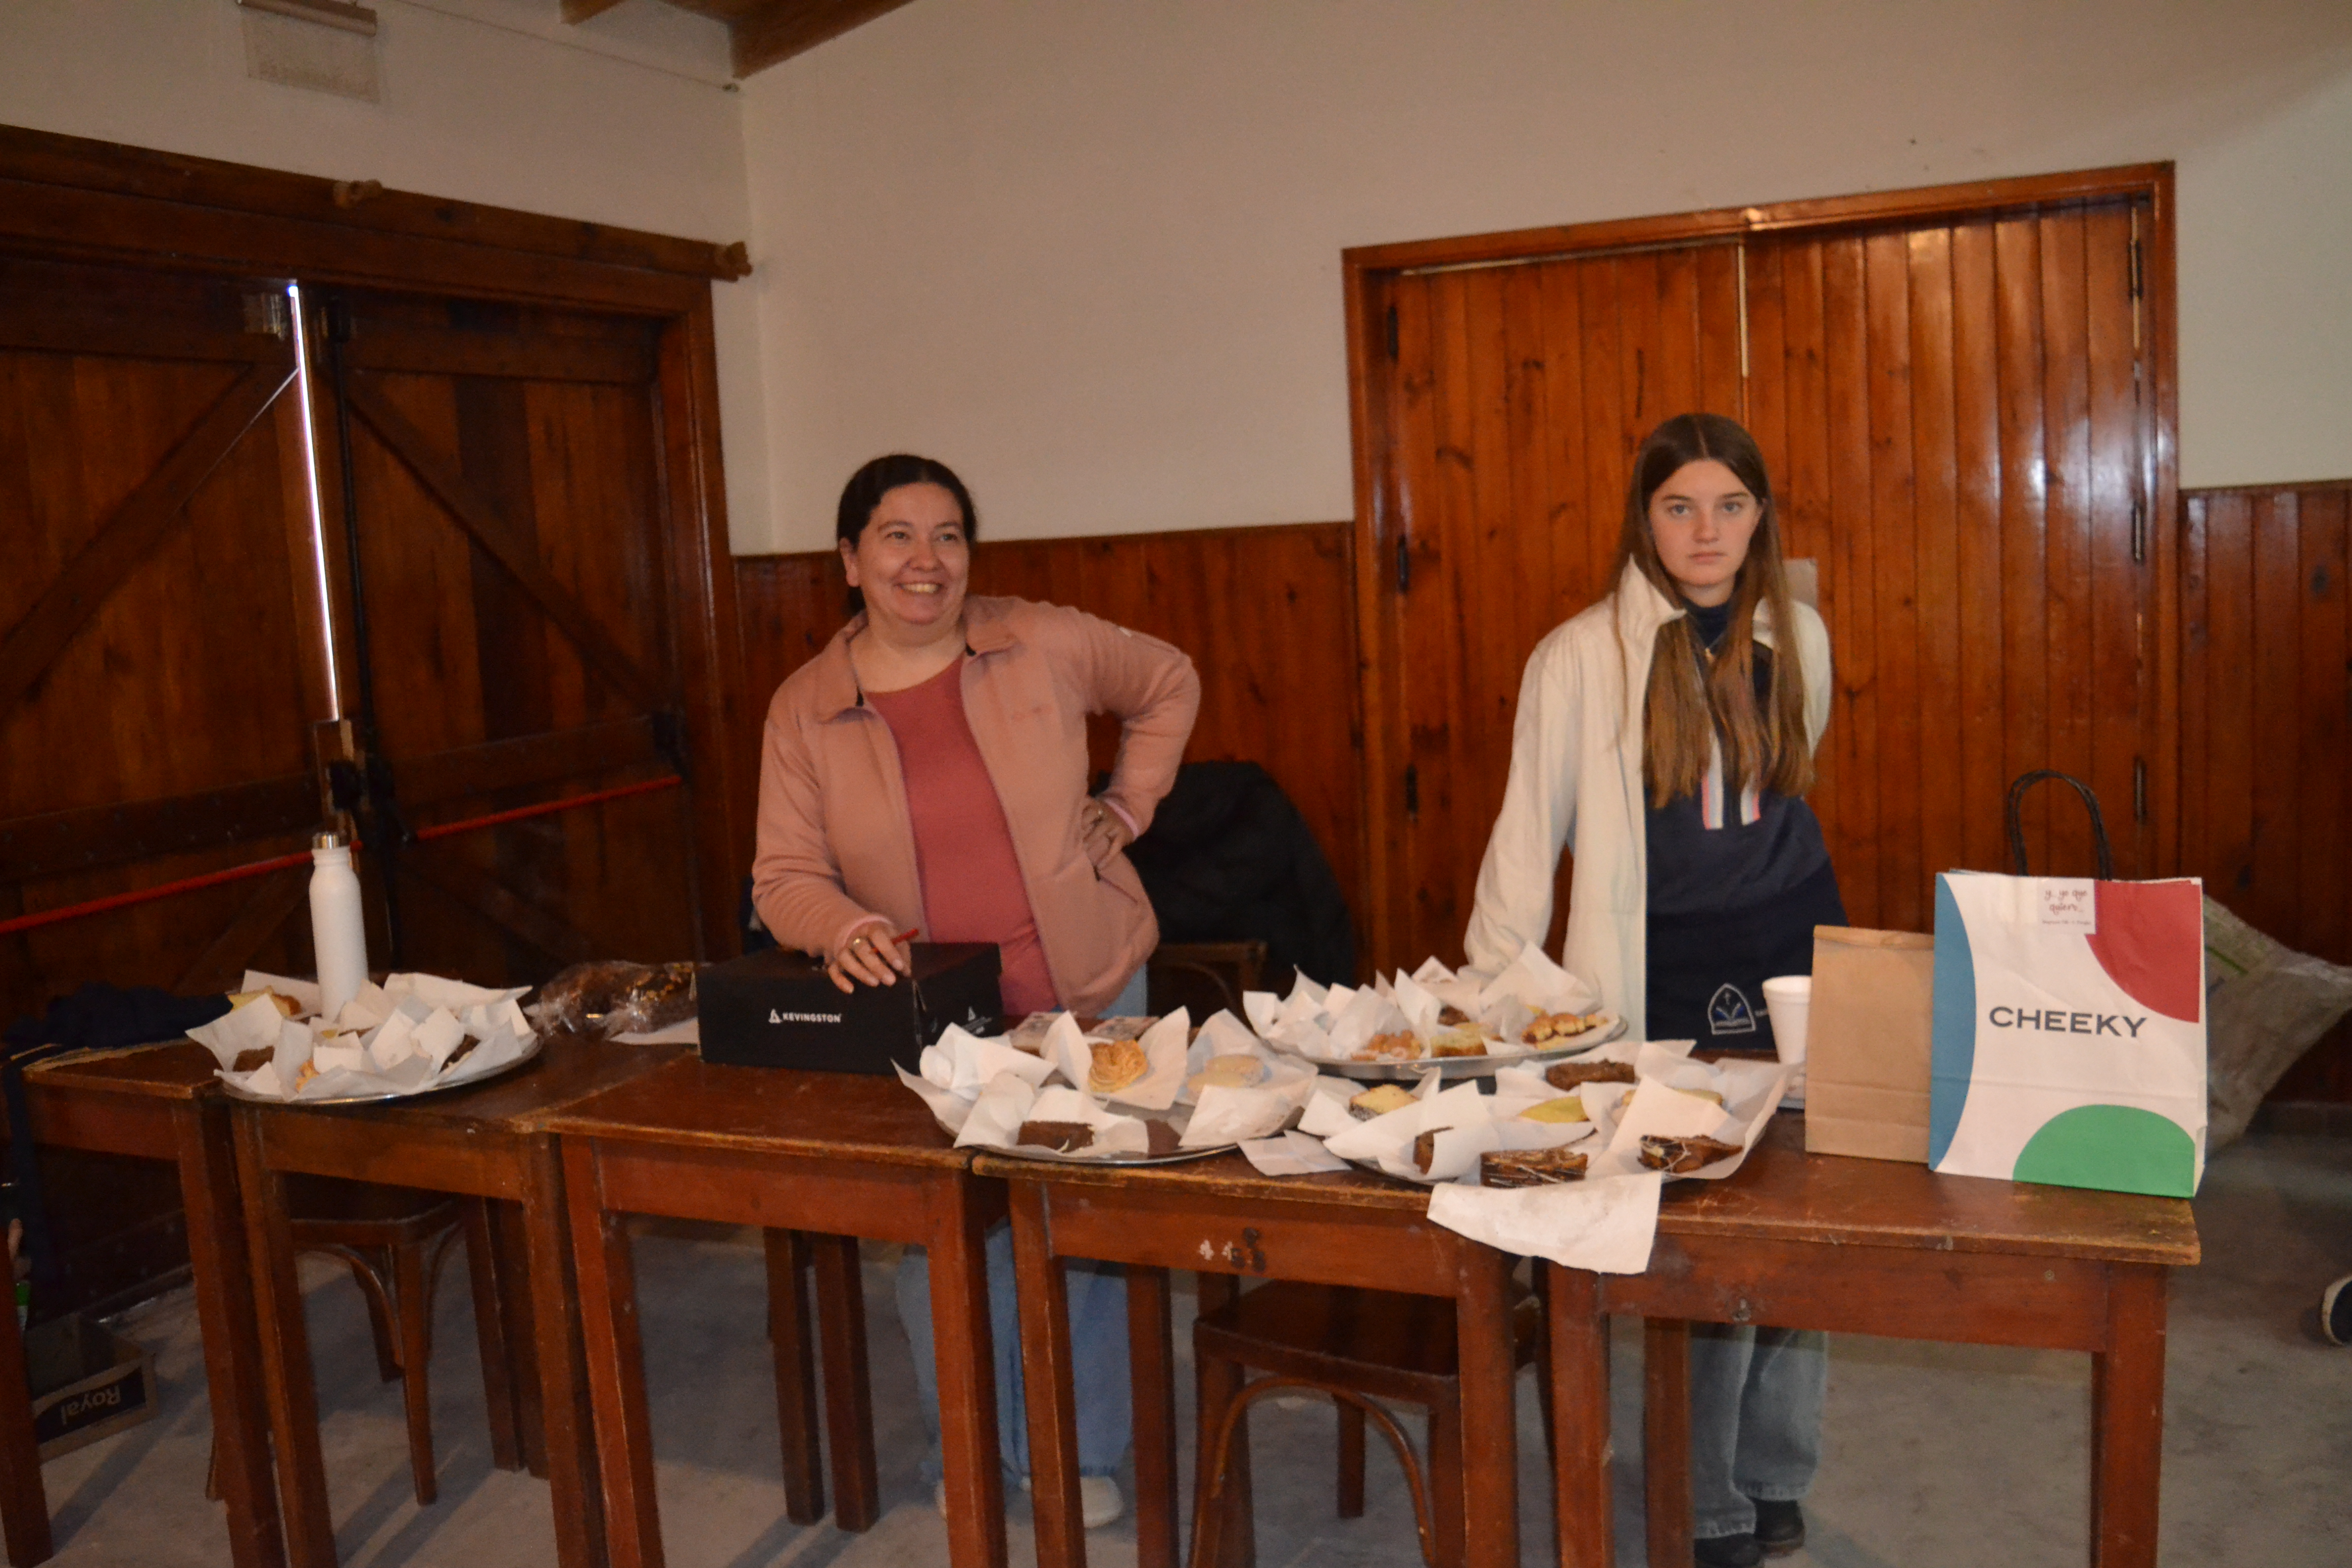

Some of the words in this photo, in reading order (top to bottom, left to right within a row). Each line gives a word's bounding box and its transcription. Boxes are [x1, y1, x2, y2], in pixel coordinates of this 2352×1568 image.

[782, 1012, 841, 1023] KEVINGSTON
[1989, 1006, 2147, 1037] CHEEKY
[61, 1384, 121, 1426] Royal
